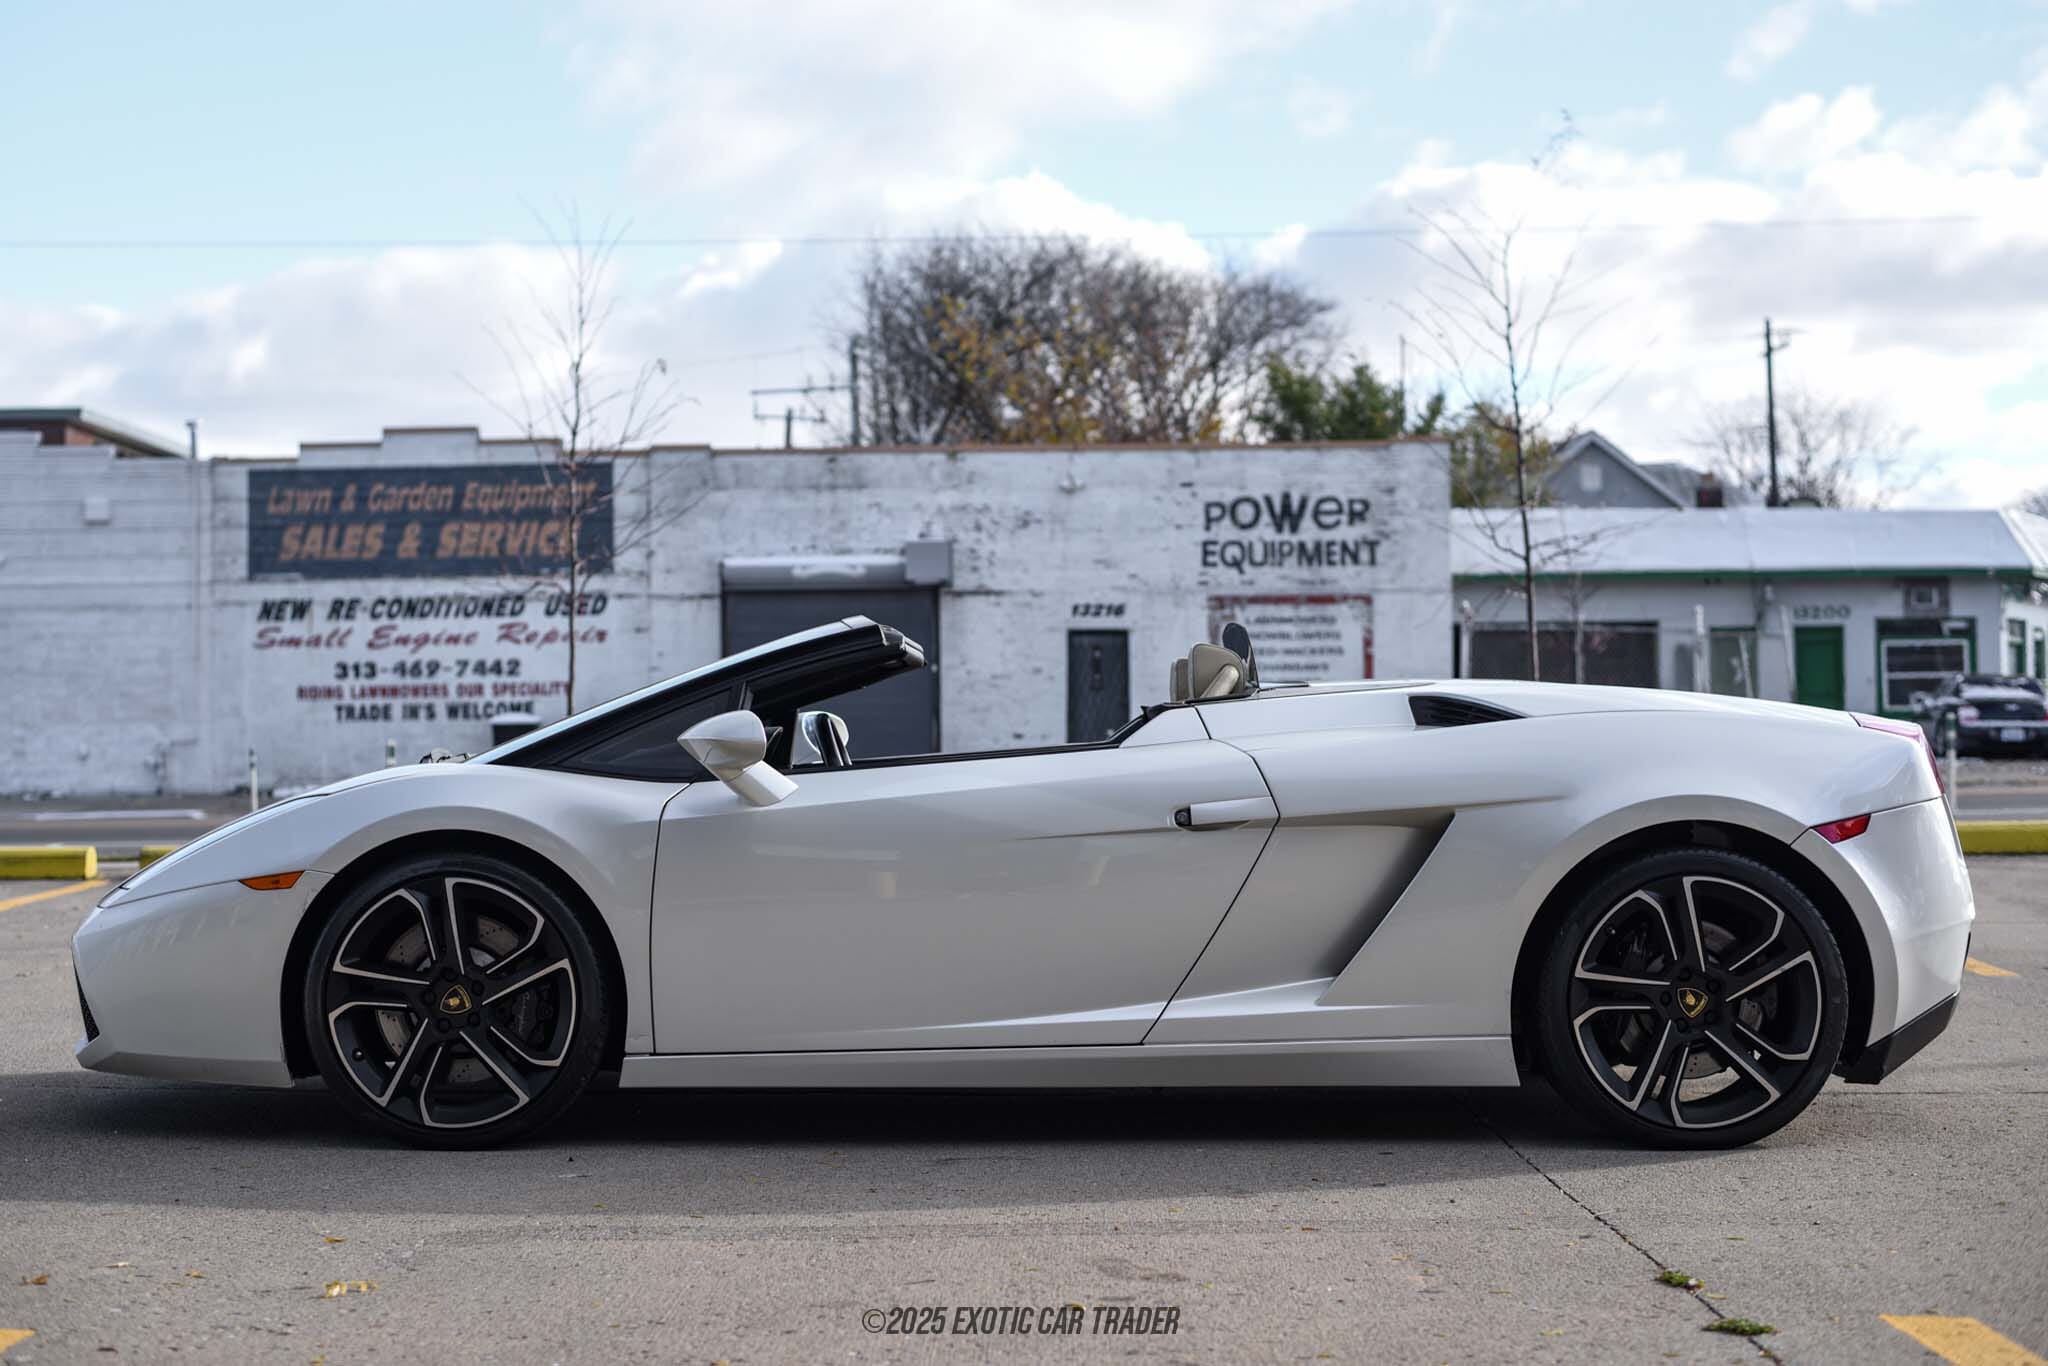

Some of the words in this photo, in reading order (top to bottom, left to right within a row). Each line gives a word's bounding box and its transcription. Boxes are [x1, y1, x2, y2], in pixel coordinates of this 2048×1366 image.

[267, 484, 332, 514] Lawn
[368, 480, 454, 512] Garden
[278, 523, 385, 561] SALES
[397, 522, 422, 559] &
[1201, 538, 1381, 575] EQUIPMENT
[257, 599, 312, 622] NEW
[545, 593, 608, 617] USED
[1071, 602, 1126, 618] 13216
[253, 626, 352, 650] Small
[367, 623, 479, 654] Engine
[335, 659, 522, 680] 313-469-7442
[456, 682, 484, 698] OUR
[334, 704, 394, 723] TRADE
